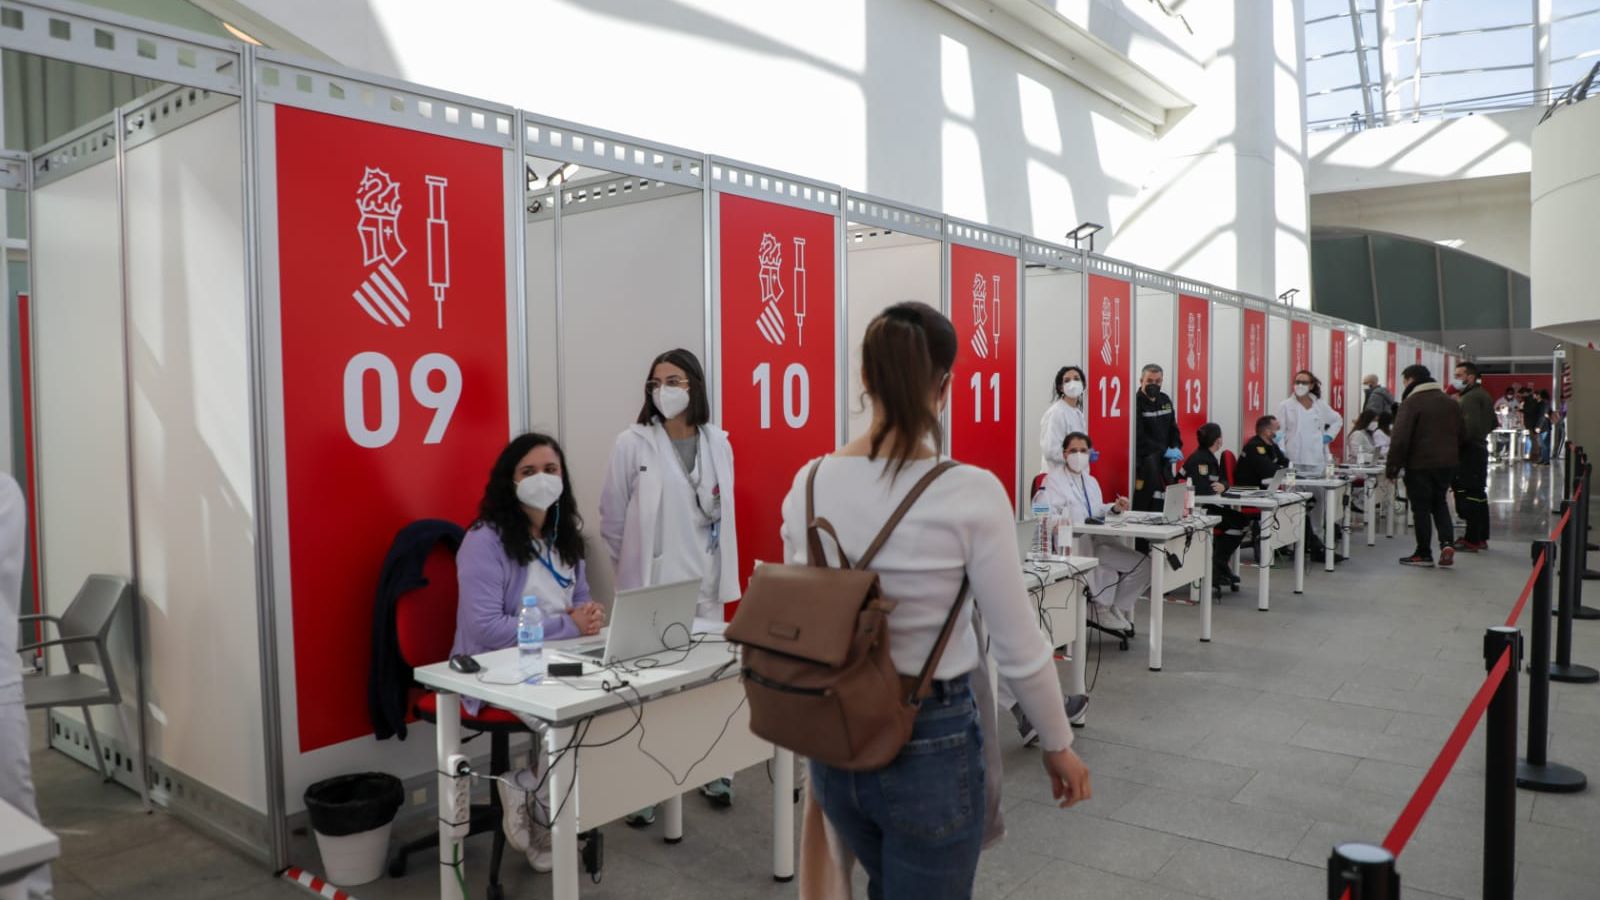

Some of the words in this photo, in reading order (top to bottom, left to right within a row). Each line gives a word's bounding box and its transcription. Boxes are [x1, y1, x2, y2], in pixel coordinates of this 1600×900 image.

[343, 351, 463, 449] 09
[752, 362, 810, 429] 10
[971, 371, 1001, 423] 11
[1099, 375, 1121, 418] 12
[1185, 378, 1202, 414] 13
[1248, 381, 1260, 411] 14
